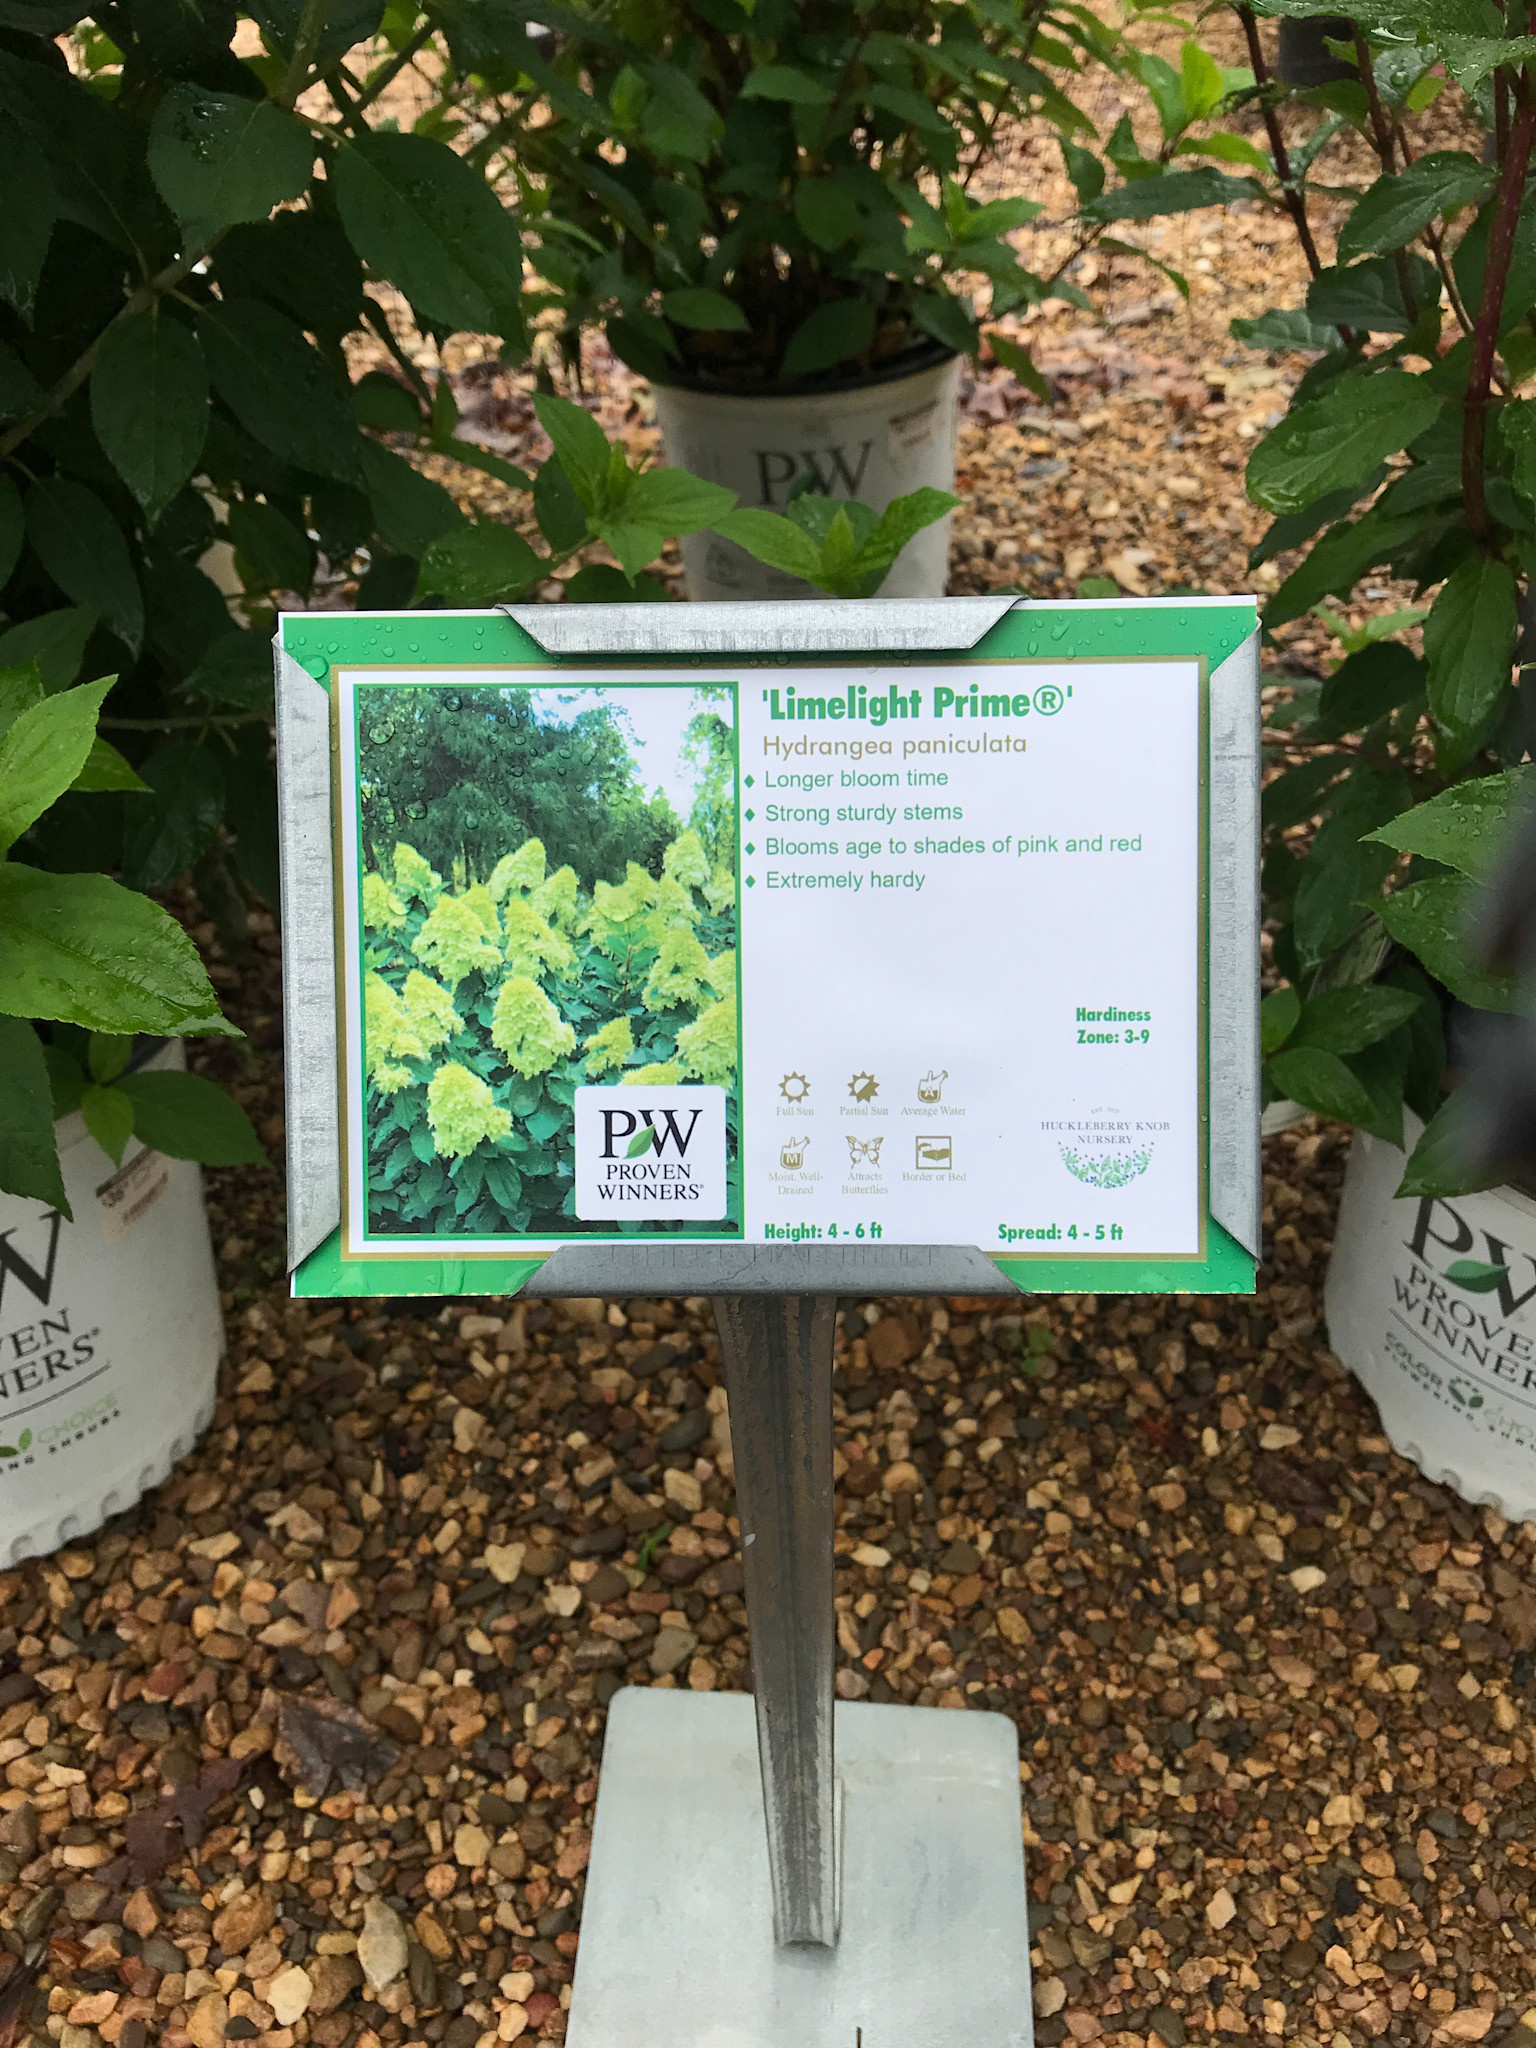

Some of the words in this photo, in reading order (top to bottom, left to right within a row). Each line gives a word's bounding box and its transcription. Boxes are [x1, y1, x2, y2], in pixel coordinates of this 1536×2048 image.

[762, 685, 922, 726] 'Limelight
[763, 735, 893, 760] Hydrangea
[903, 733, 1027, 759] paniculata
[765, 771, 835, 791] Longer
[840, 769, 900, 788] bloom
[907, 769, 949, 787] time
[765, 804, 830, 825] Strong
[836, 803, 897, 825] sturdy
[903, 805, 963, 821] stems
[766, 837, 839, 856] Blooms
[846, 840, 883, 859] age
[888, 839, 907, 855] to
[914, 836, 986, 855] shades
[992, 835, 1011, 853] of
[1018, 834, 1059, 857] pink
[1065, 835, 1102, 852] and
[1110, 834, 1142, 852] red
[766, 872, 864, 891] Extremely
[870, 870, 926, 891] hardy
[1075, 1007, 1152, 1023] Hardiness
[1077, 1030, 1120, 1044] Zone:
[1124, 1029, 1150, 1045] 3-9
[776, 1107, 794, 1116] Full
[796, 1107, 815, 1116] Sun
[840, 1106, 869, 1116] Partial
[870, 1106, 889, 1116] Sun
[900, 1106, 938, 1117] Average
[939, 1106, 966, 1116] Water
[598, 1109, 703, 1158] PW
[1040, 1121, 1132, 1131] HUCKLEBERRY
[1136, 1121, 1170, 1131] KNOB
[1077, 1135, 1133, 1144] NURSERY
[606, 1164, 691, 1180] PROVEN
[768, 1172, 796, 1182] Moist,
[799, 1172, 824, 1181] Well-
[848, 1172, 883, 1181] Attracts
[902, 1172, 933, 1181] Border
[948, 1172, 966, 1181] Bed
[778, 1185, 814, 1195] Drained
[841, 1185, 888, 1195] Butterflies
[764, 1223, 823, 1241] Height:
[827, 1223, 838, 1239] 4
[856, 1223, 866, 1239] 6
[869, 1222, 883, 1239] ft
[998, 1224, 1062, 1242] Spread:
[1066, 1224, 1078, 1240] 4
[1095, 1225, 1105, 1240] 5
[1109, 1224, 1124, 1241] ft
[1410, 1262, 1536, 1364] PROVE
